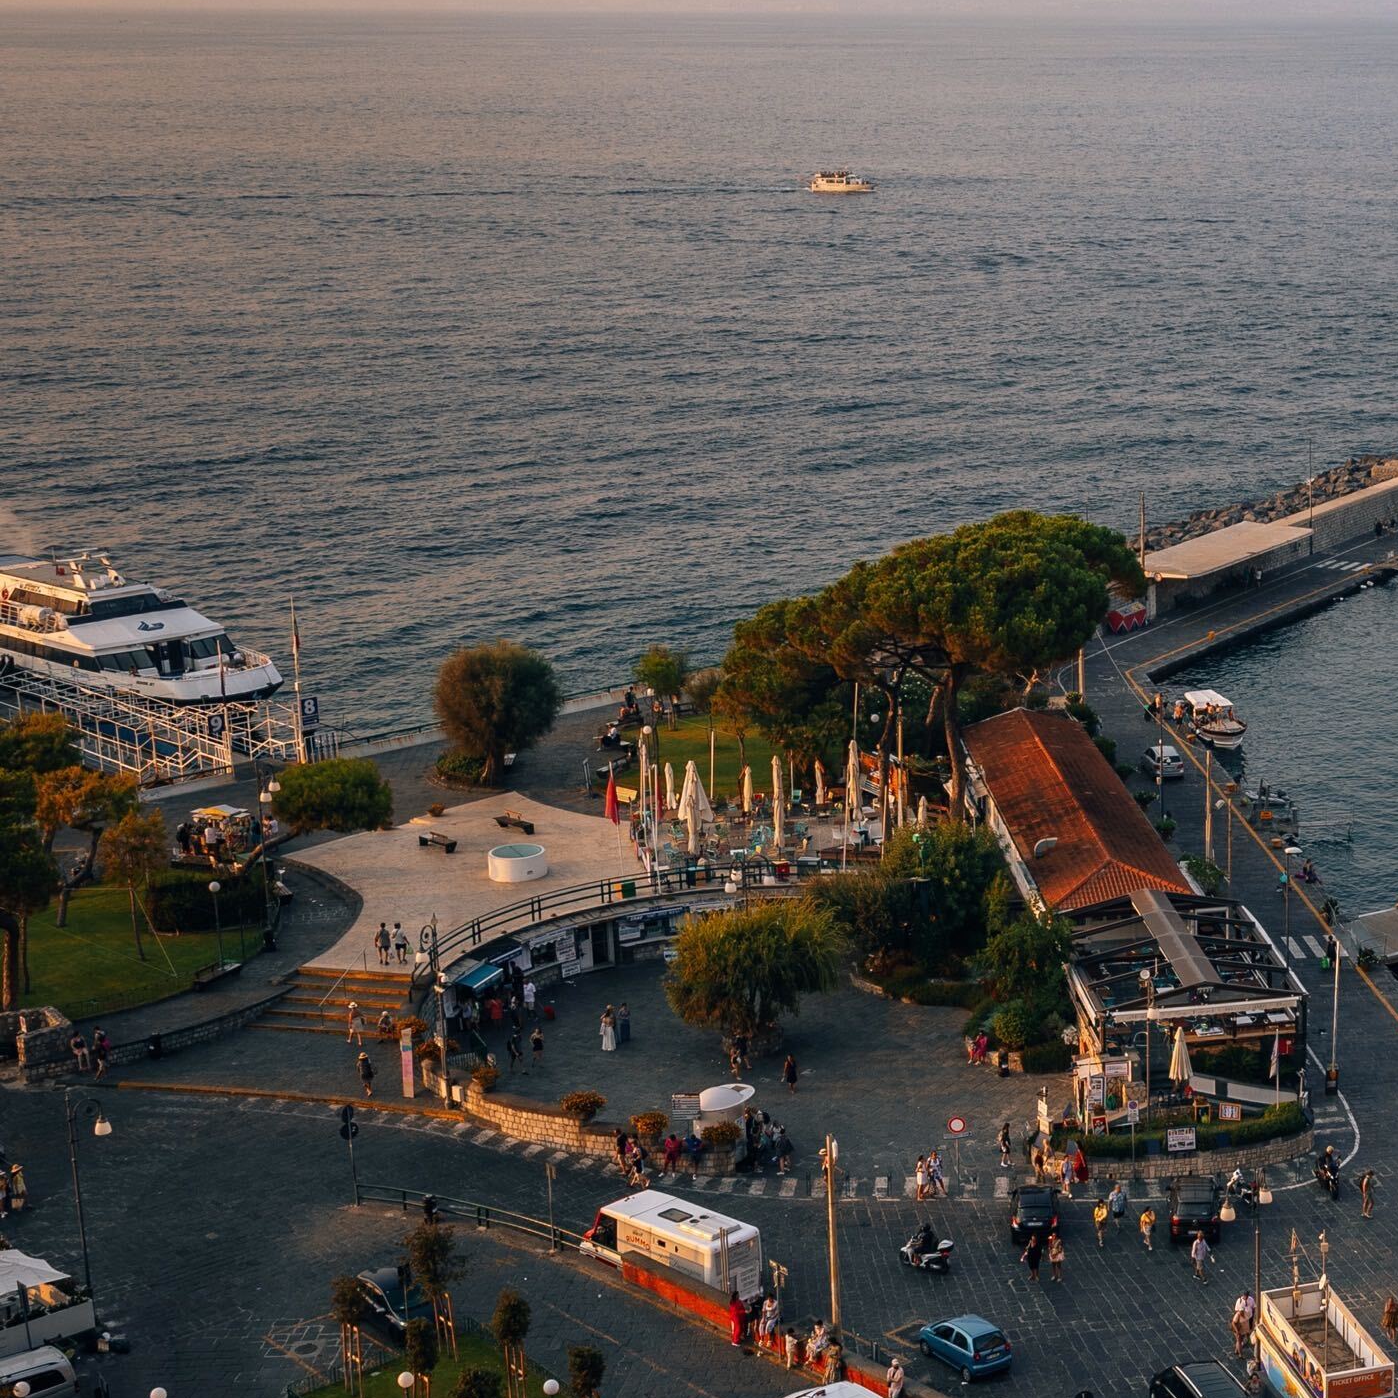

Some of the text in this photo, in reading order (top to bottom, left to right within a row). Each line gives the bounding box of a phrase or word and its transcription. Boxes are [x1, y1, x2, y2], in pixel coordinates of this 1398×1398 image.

[303, 699, 316, 714] 8
[210, 715, 222, 732] 9
[1332, 1373, 1375, 1387] TICKET OFFICE
